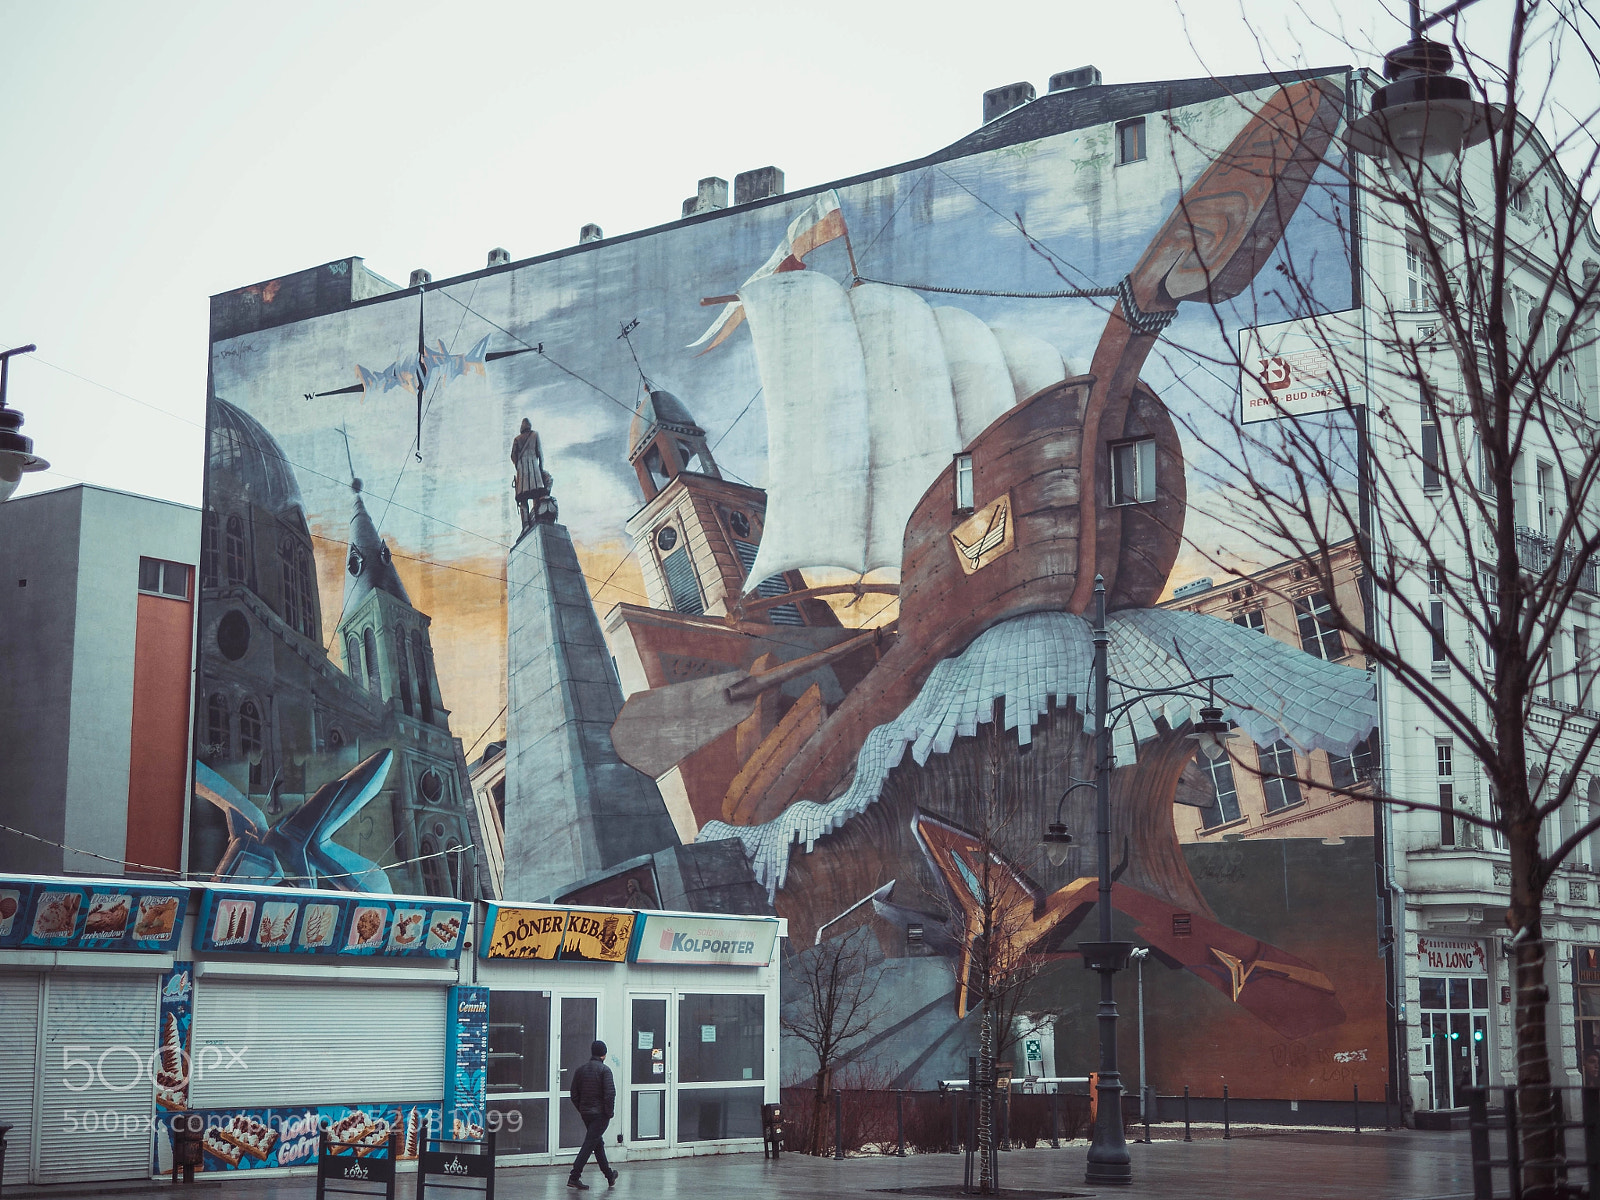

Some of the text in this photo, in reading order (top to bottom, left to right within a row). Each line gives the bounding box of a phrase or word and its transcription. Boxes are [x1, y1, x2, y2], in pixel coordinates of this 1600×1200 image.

[304, 391, 316, 401] W
[1249, 395, 1279, 408] REMO
[1286, 391, 1308, 402] BUD
[415, 452, 423, 463] S
[38, 892, 70, 904] Deser
[91, 893, 121, 904] Deser
[143, 895, 172, 906] Deser
[502, 915, 618, 950] DÖNER KEBAB
[1429, 941, 1471, 951] RESTAURACJA
[1428, 952, 1474, 969] HA LONG
[458, 1001, 487, 1013] Cennik
